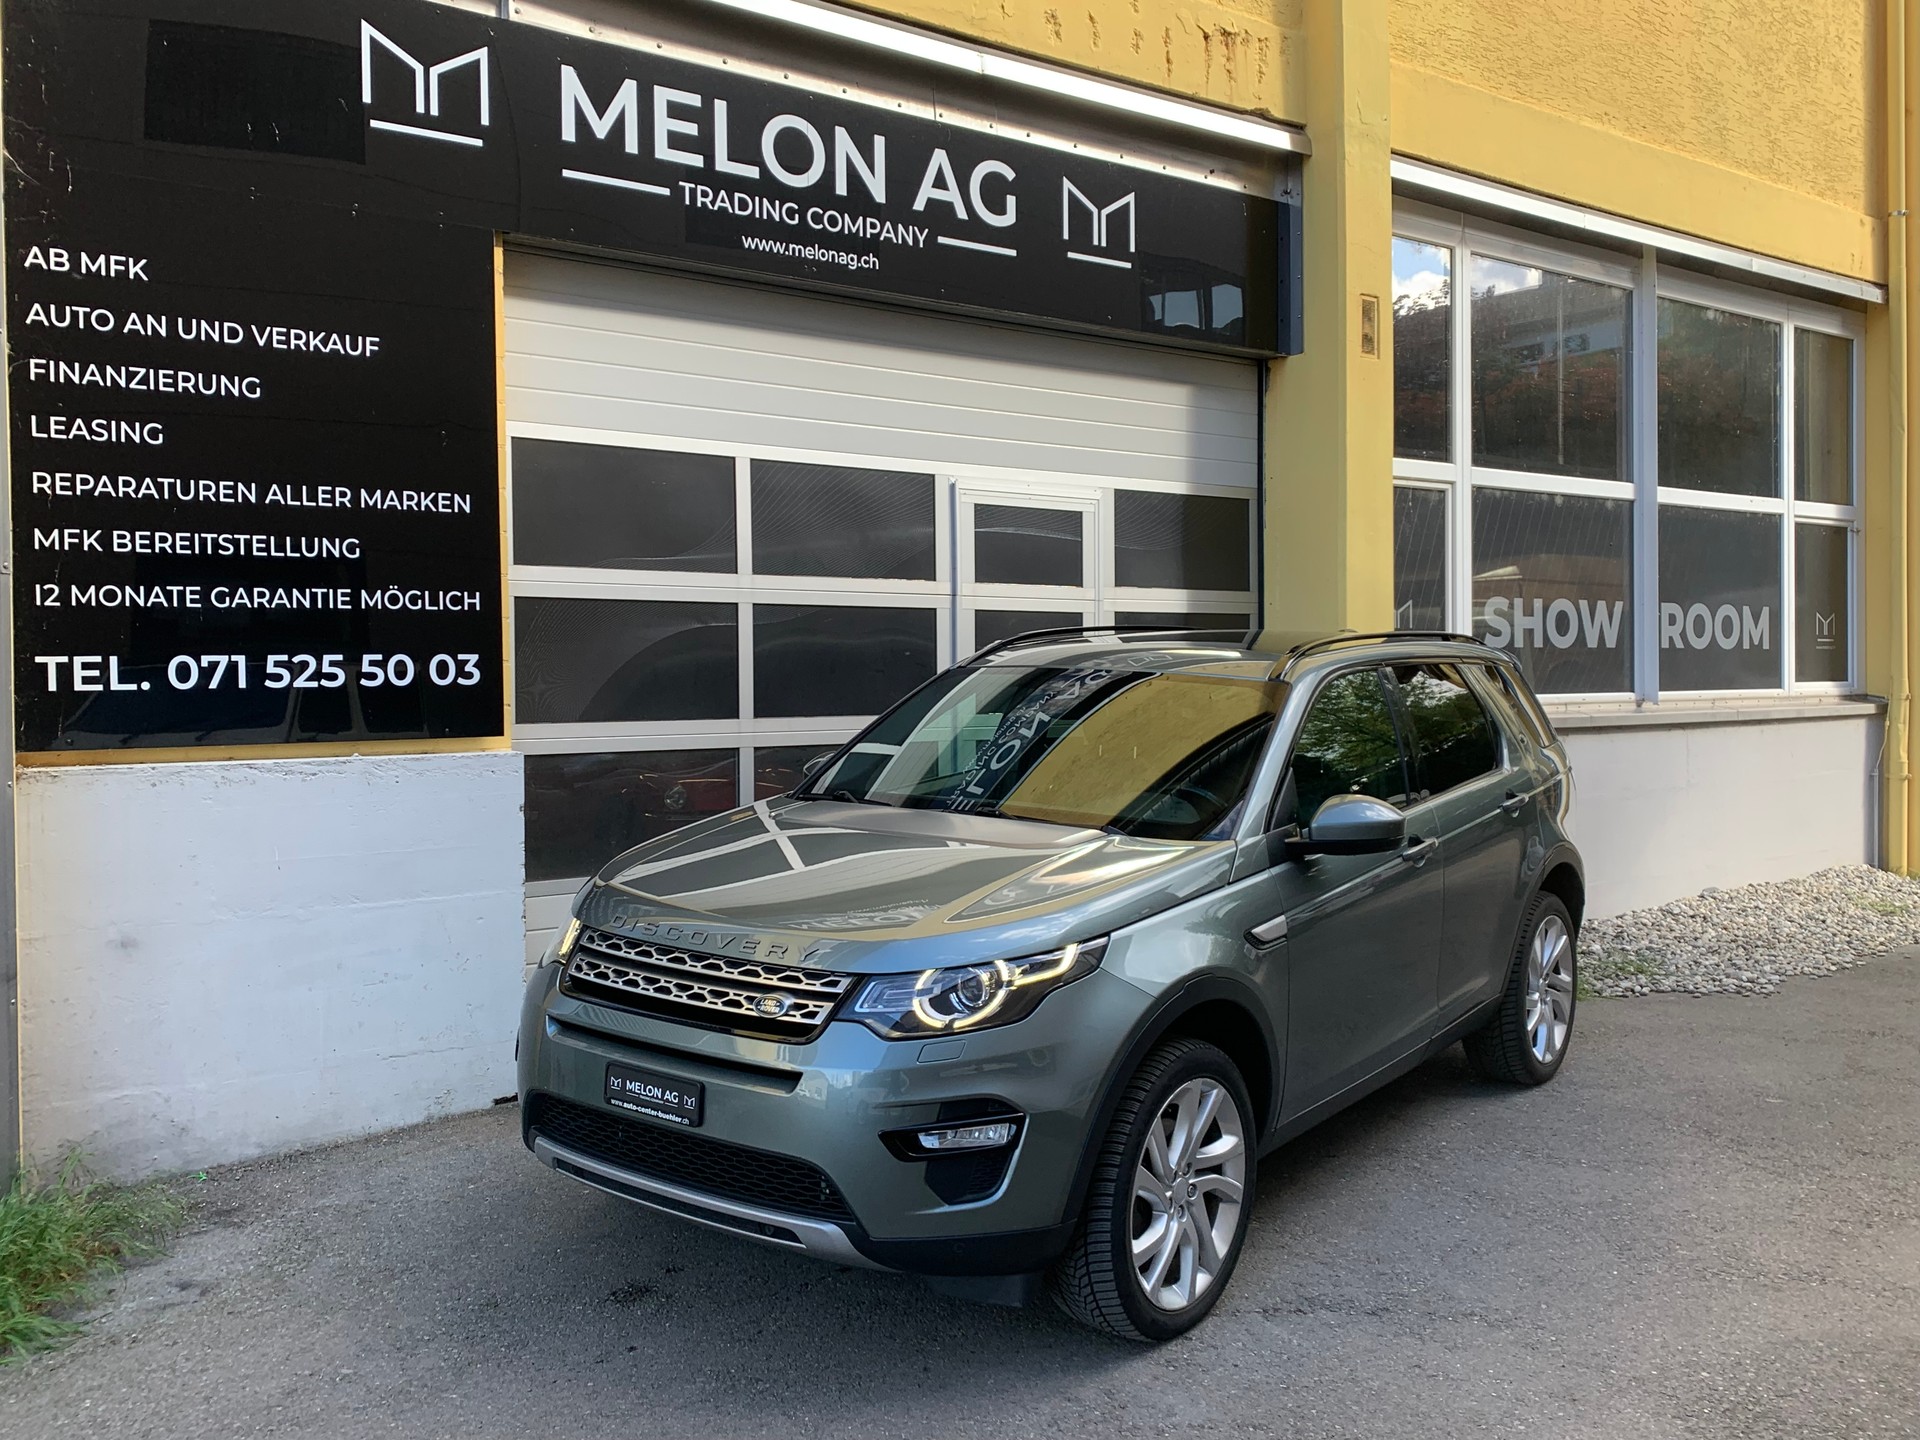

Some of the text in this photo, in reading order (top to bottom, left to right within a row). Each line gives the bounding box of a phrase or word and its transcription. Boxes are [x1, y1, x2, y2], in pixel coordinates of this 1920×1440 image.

[561, 64, 1017, 228] MELON AG
[679, 182, 929, 250] TRADING COMPANY
[24, 246, 148, 280] AB MFK
[742, 235, 879, 270] www.melonag.ch
[26, 303, 379, 356] AUTO AN UND VERKAUF
[30, 359, 260, 398] FINANZIERUNG
[31, 415, 163, 444] LEASING
[33, 472, 470, 513] REPARATUREN ALLER MARKEN
[34, 528, 359, 558] MFK BEREITSTELLUNG
[72, 585, 201, 607] MONATE
[211, 587, 351, 609] GARANTIE
[361, 586, 480, 610] MÖGLICH
[1485, 596, 1770, 650] SHOW ROOM
[35, 654, 480, 691] TEL. 071 525 50 03
[610, 914, 820, 962] DISCOVERY
[626, 1079, 662, 1099] MELON
[664, 1090, 679, 1103] AG
